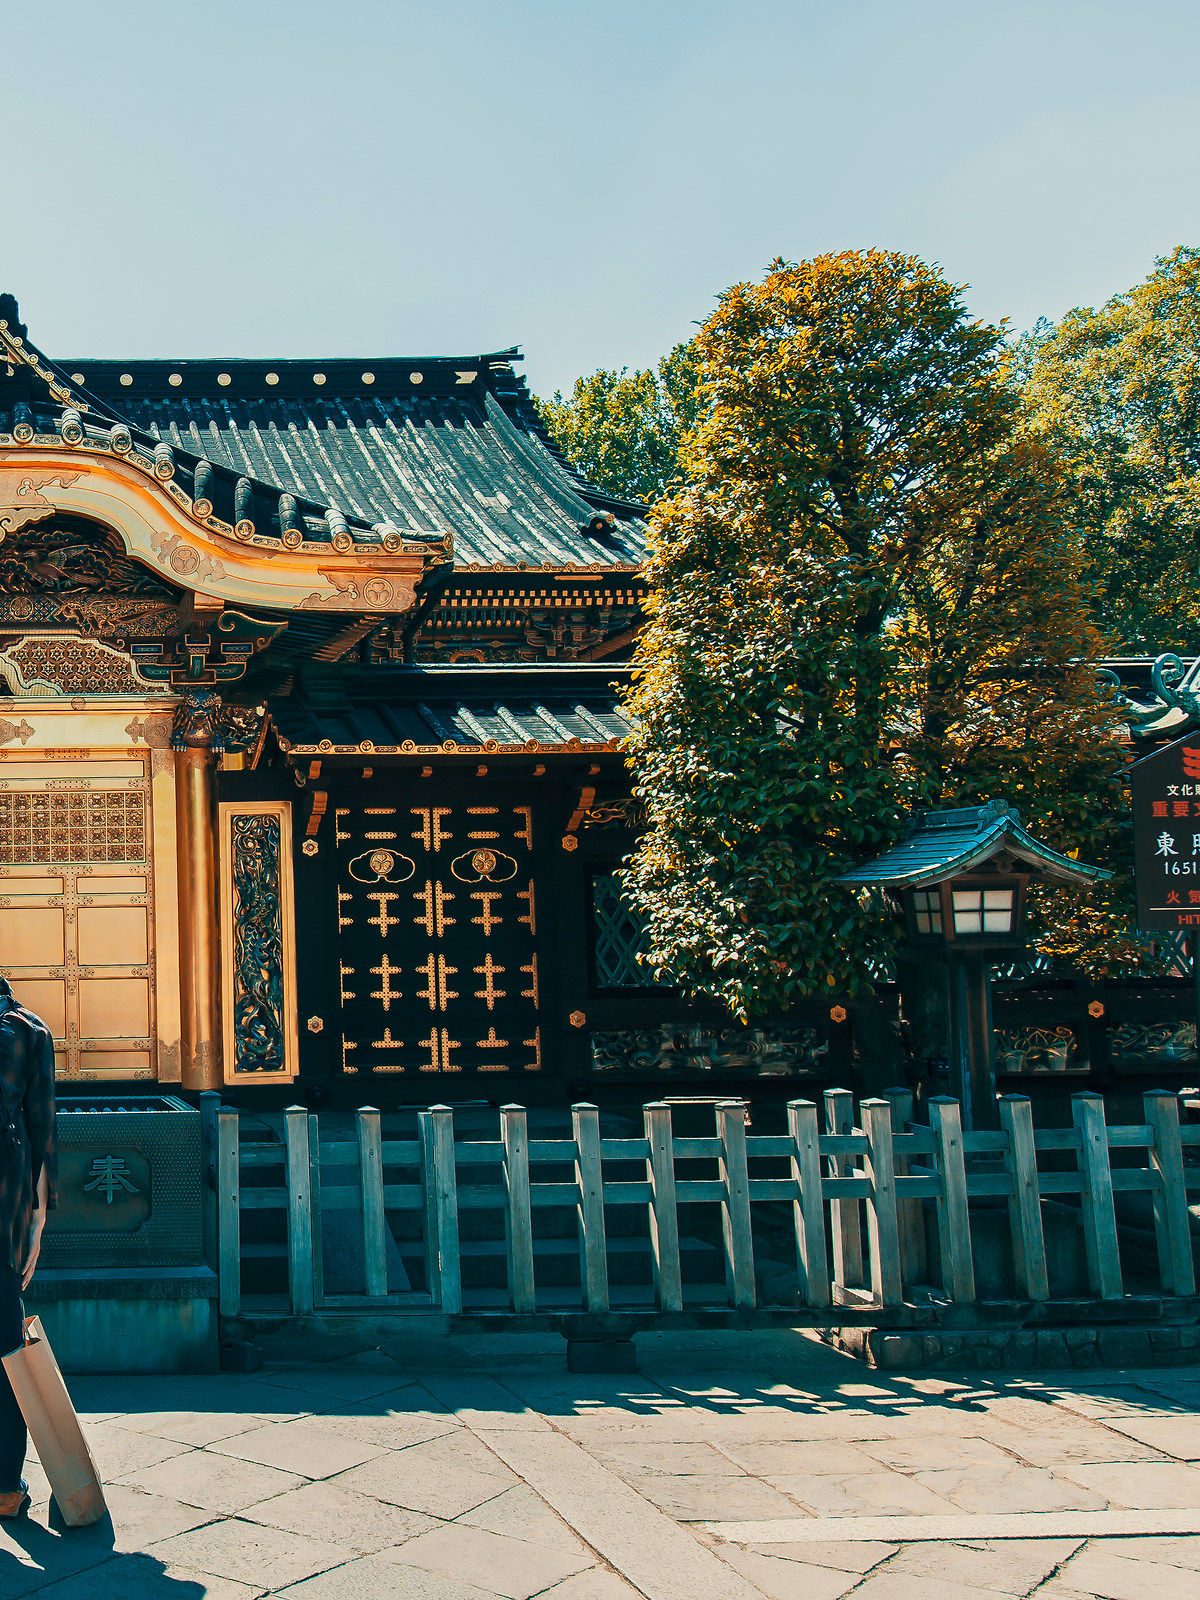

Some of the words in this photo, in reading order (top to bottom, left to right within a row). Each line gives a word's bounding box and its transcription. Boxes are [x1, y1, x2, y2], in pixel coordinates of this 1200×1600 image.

[1164, 861, 1200, 875] 1651
[1178, 915, 1200, 925] HIT
[83, 1154, 141, 1205] 奉
